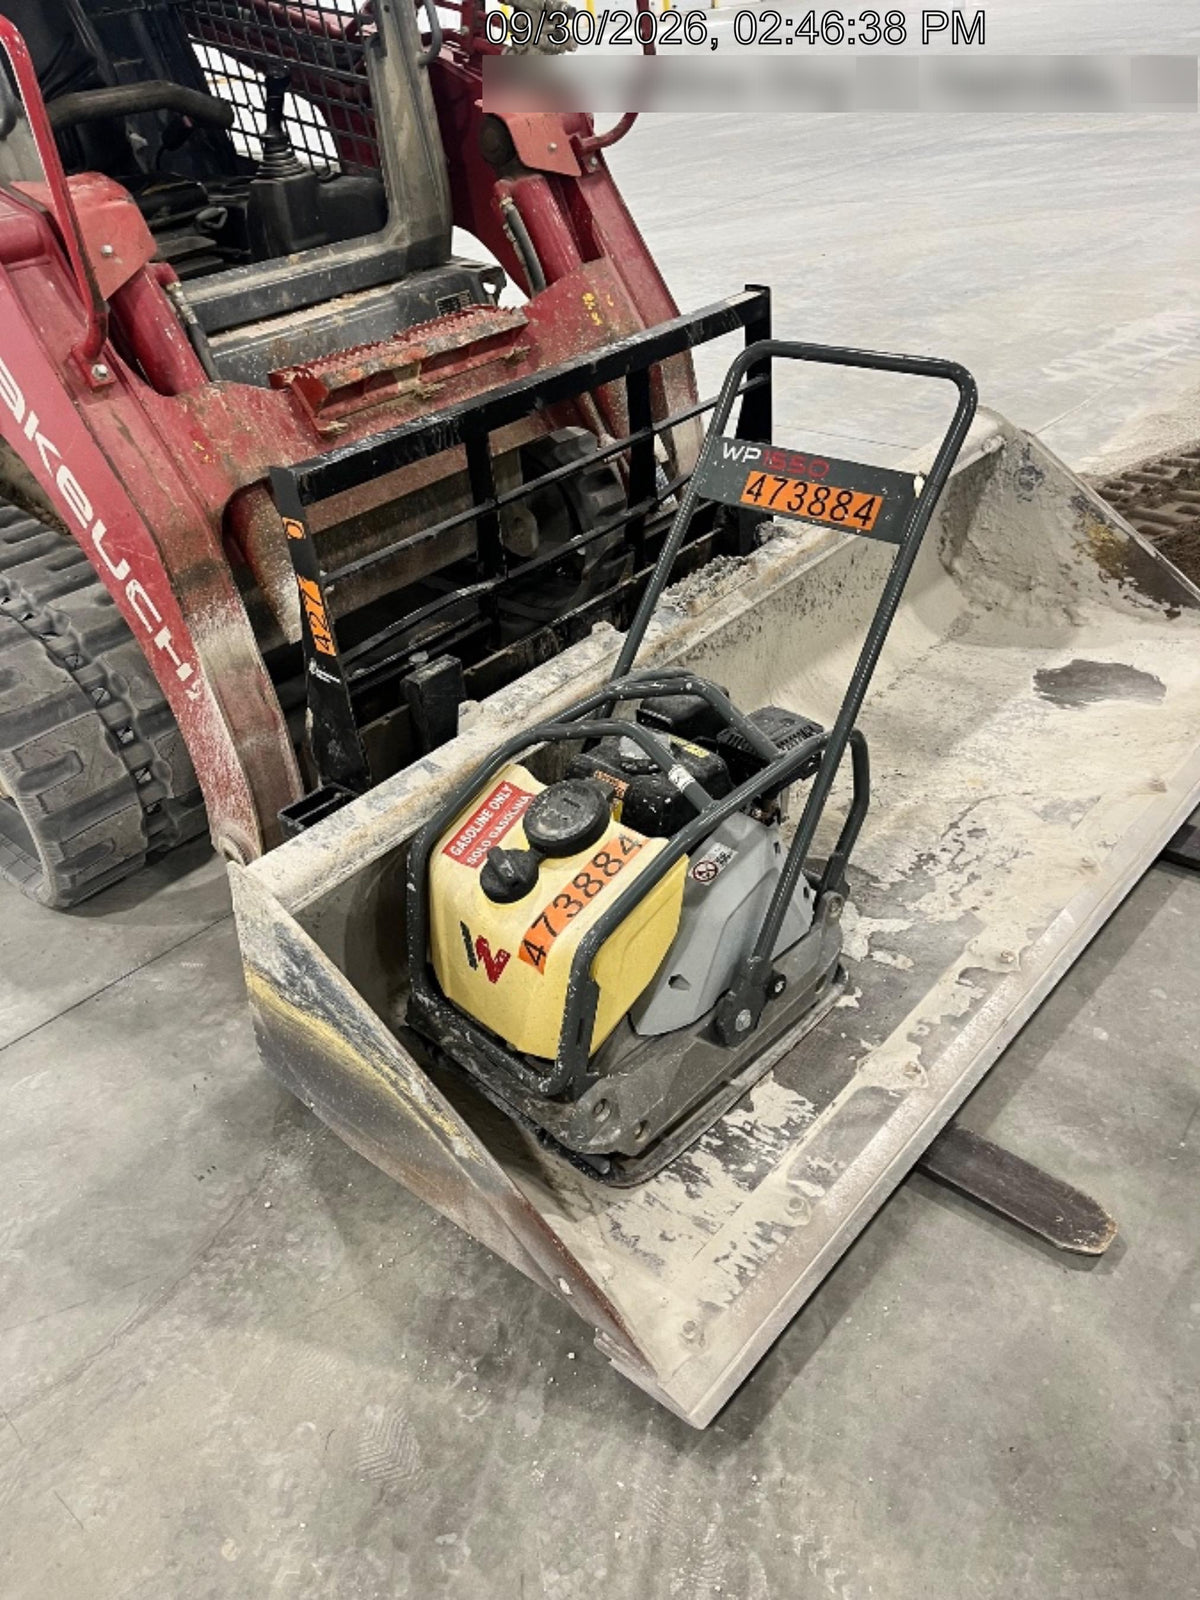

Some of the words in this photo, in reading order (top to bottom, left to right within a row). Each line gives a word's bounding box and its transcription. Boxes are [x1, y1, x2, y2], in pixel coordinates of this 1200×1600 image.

[722, 441, 830, 479] WP1550
[746, 474, 876, 527] 473884
[449, 808, 494, 857] GASOLINE
[488, 783, 514, 811] ONLY
[466, 840, 492, 865] SOLO
[521, 833, 643, 966] 473884
